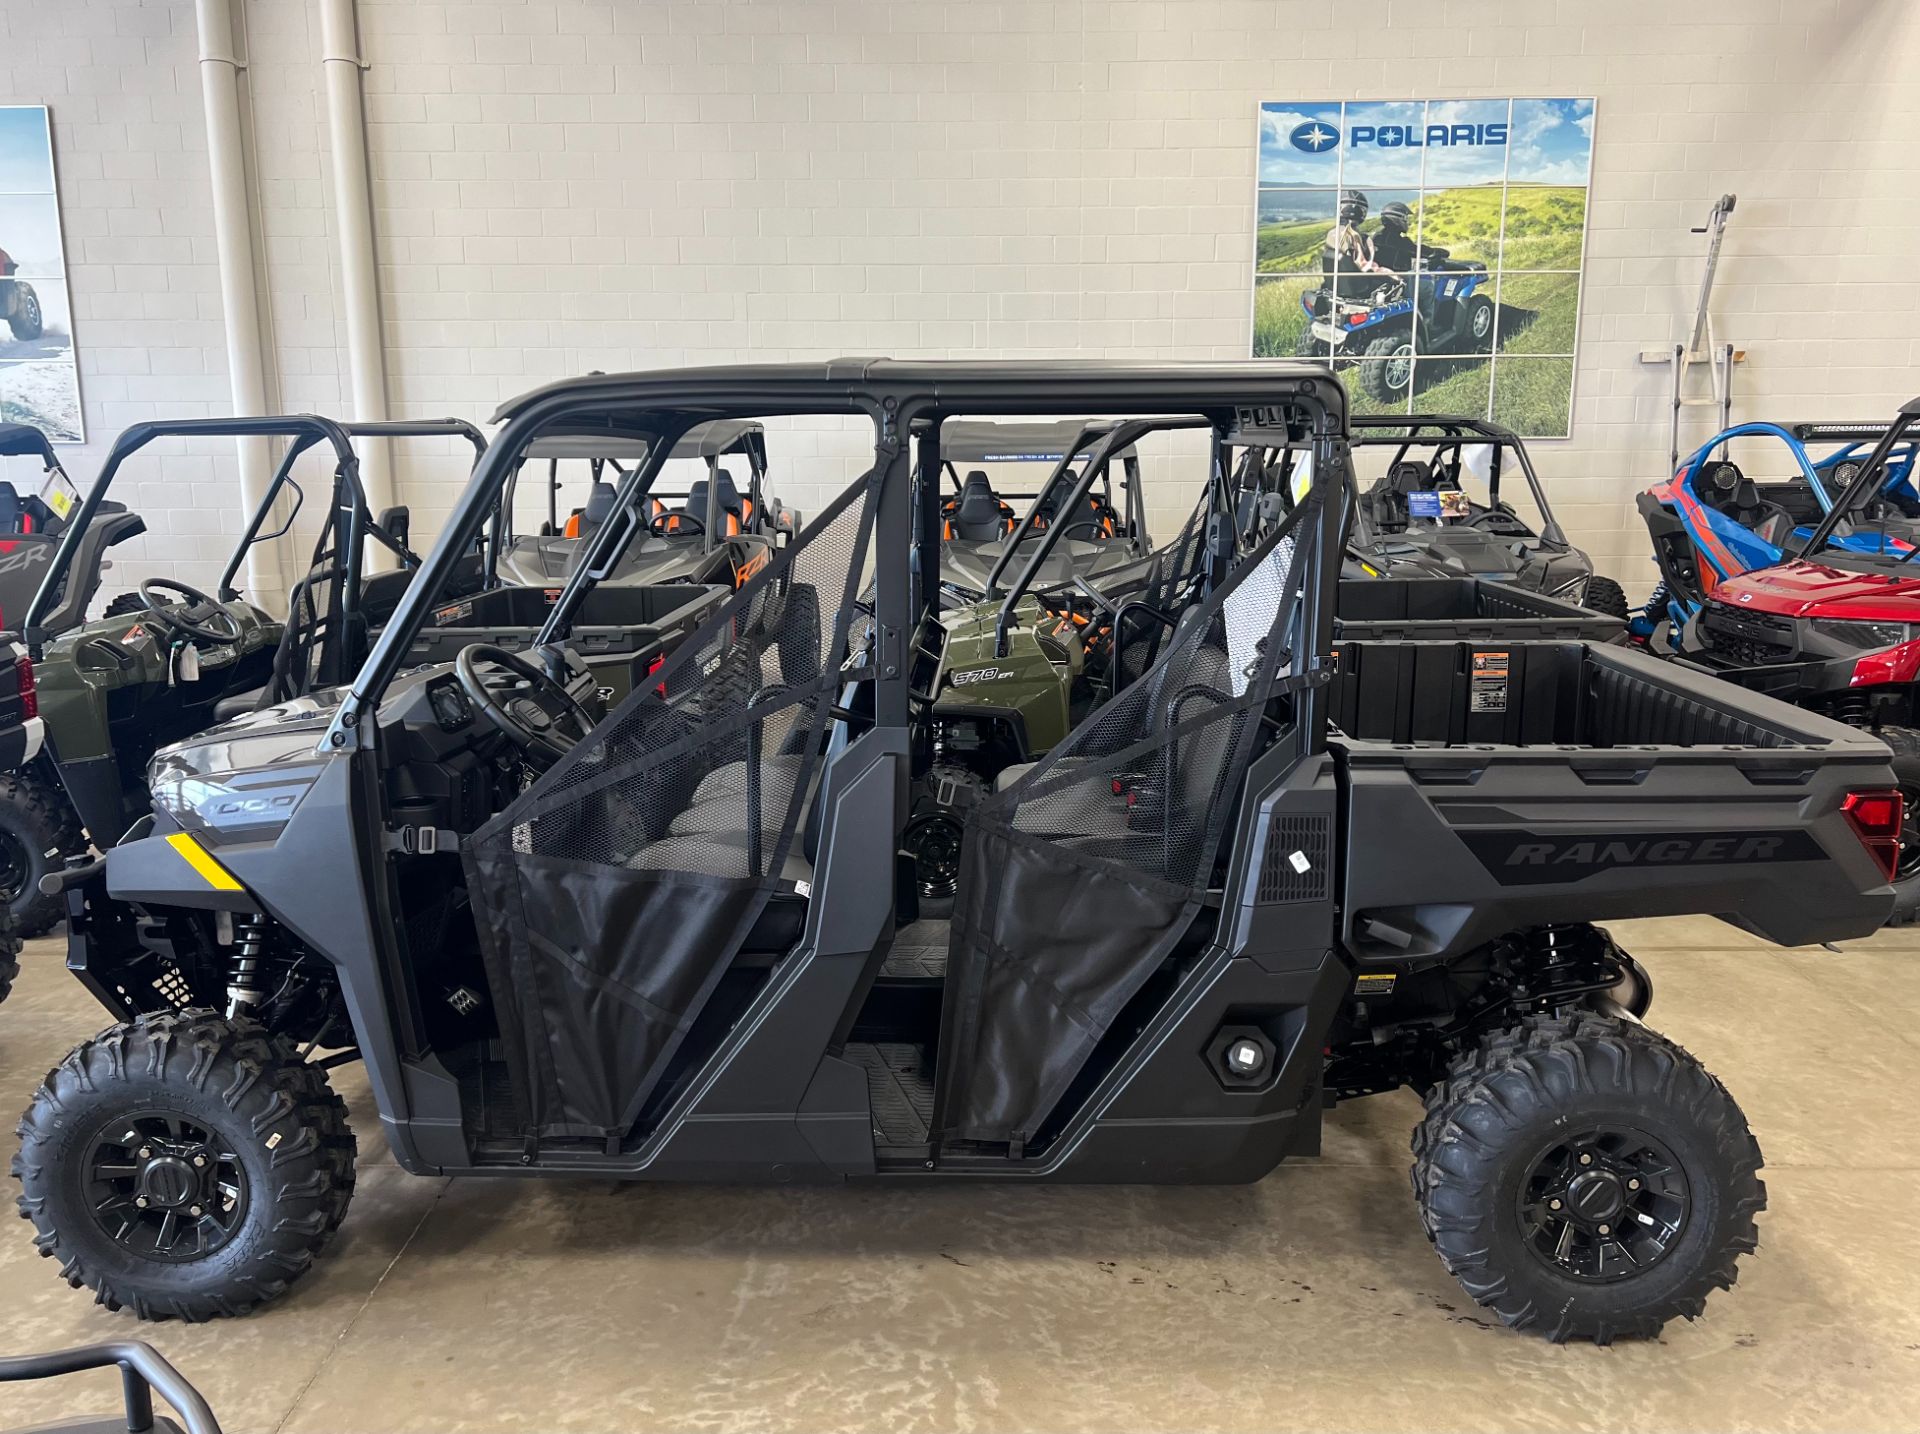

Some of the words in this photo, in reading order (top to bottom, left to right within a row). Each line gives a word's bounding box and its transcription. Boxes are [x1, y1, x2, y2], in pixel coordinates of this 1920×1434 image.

[1351, 123, 1508, 147] POLARIS
[954, 667, 999, 686] 570
[209, 794, 297, 817] 1000
[1504, 836, 1785, 865] RANGER
